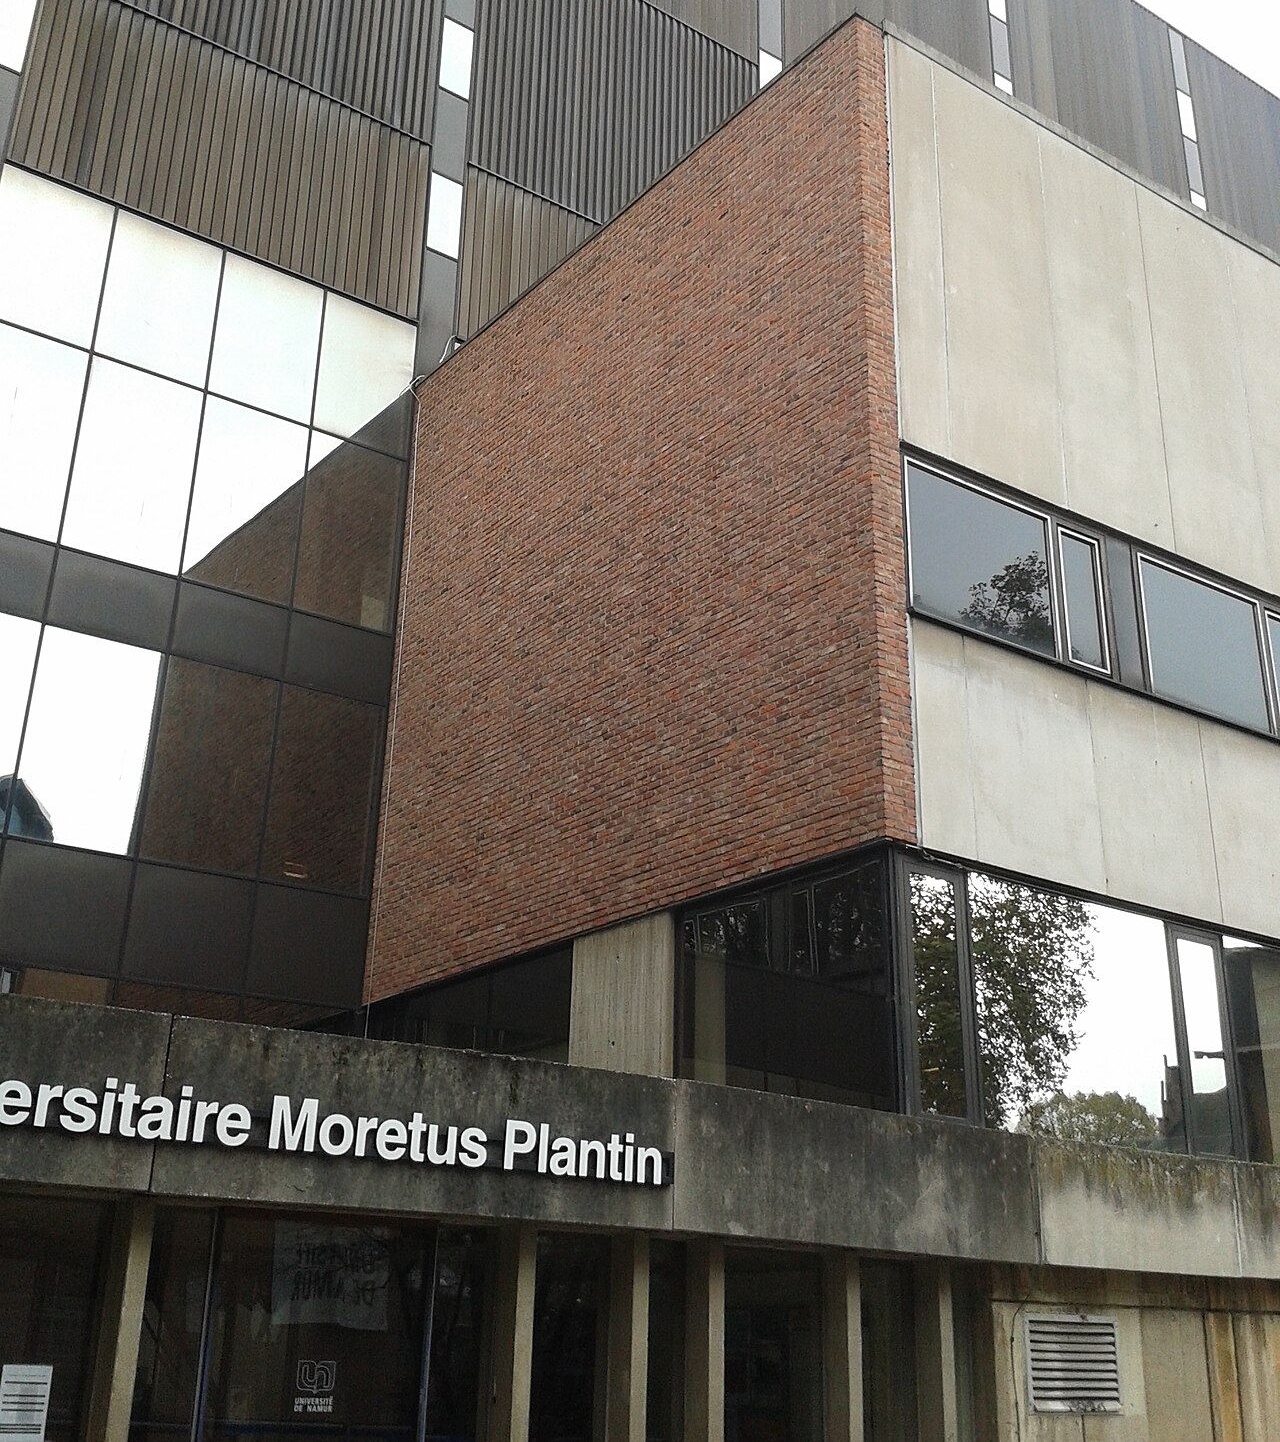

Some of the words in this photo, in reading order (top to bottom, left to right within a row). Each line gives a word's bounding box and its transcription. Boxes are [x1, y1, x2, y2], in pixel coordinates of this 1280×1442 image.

[0, 1076, 252, 1146] ersitaire
[267, 1094, 488, 1168] Moretus
[502, 1118, 663, 1186] Plantin
[293, 1404, 303, 1413] DE
[306, 1404, 333, 1413] NAMUR
